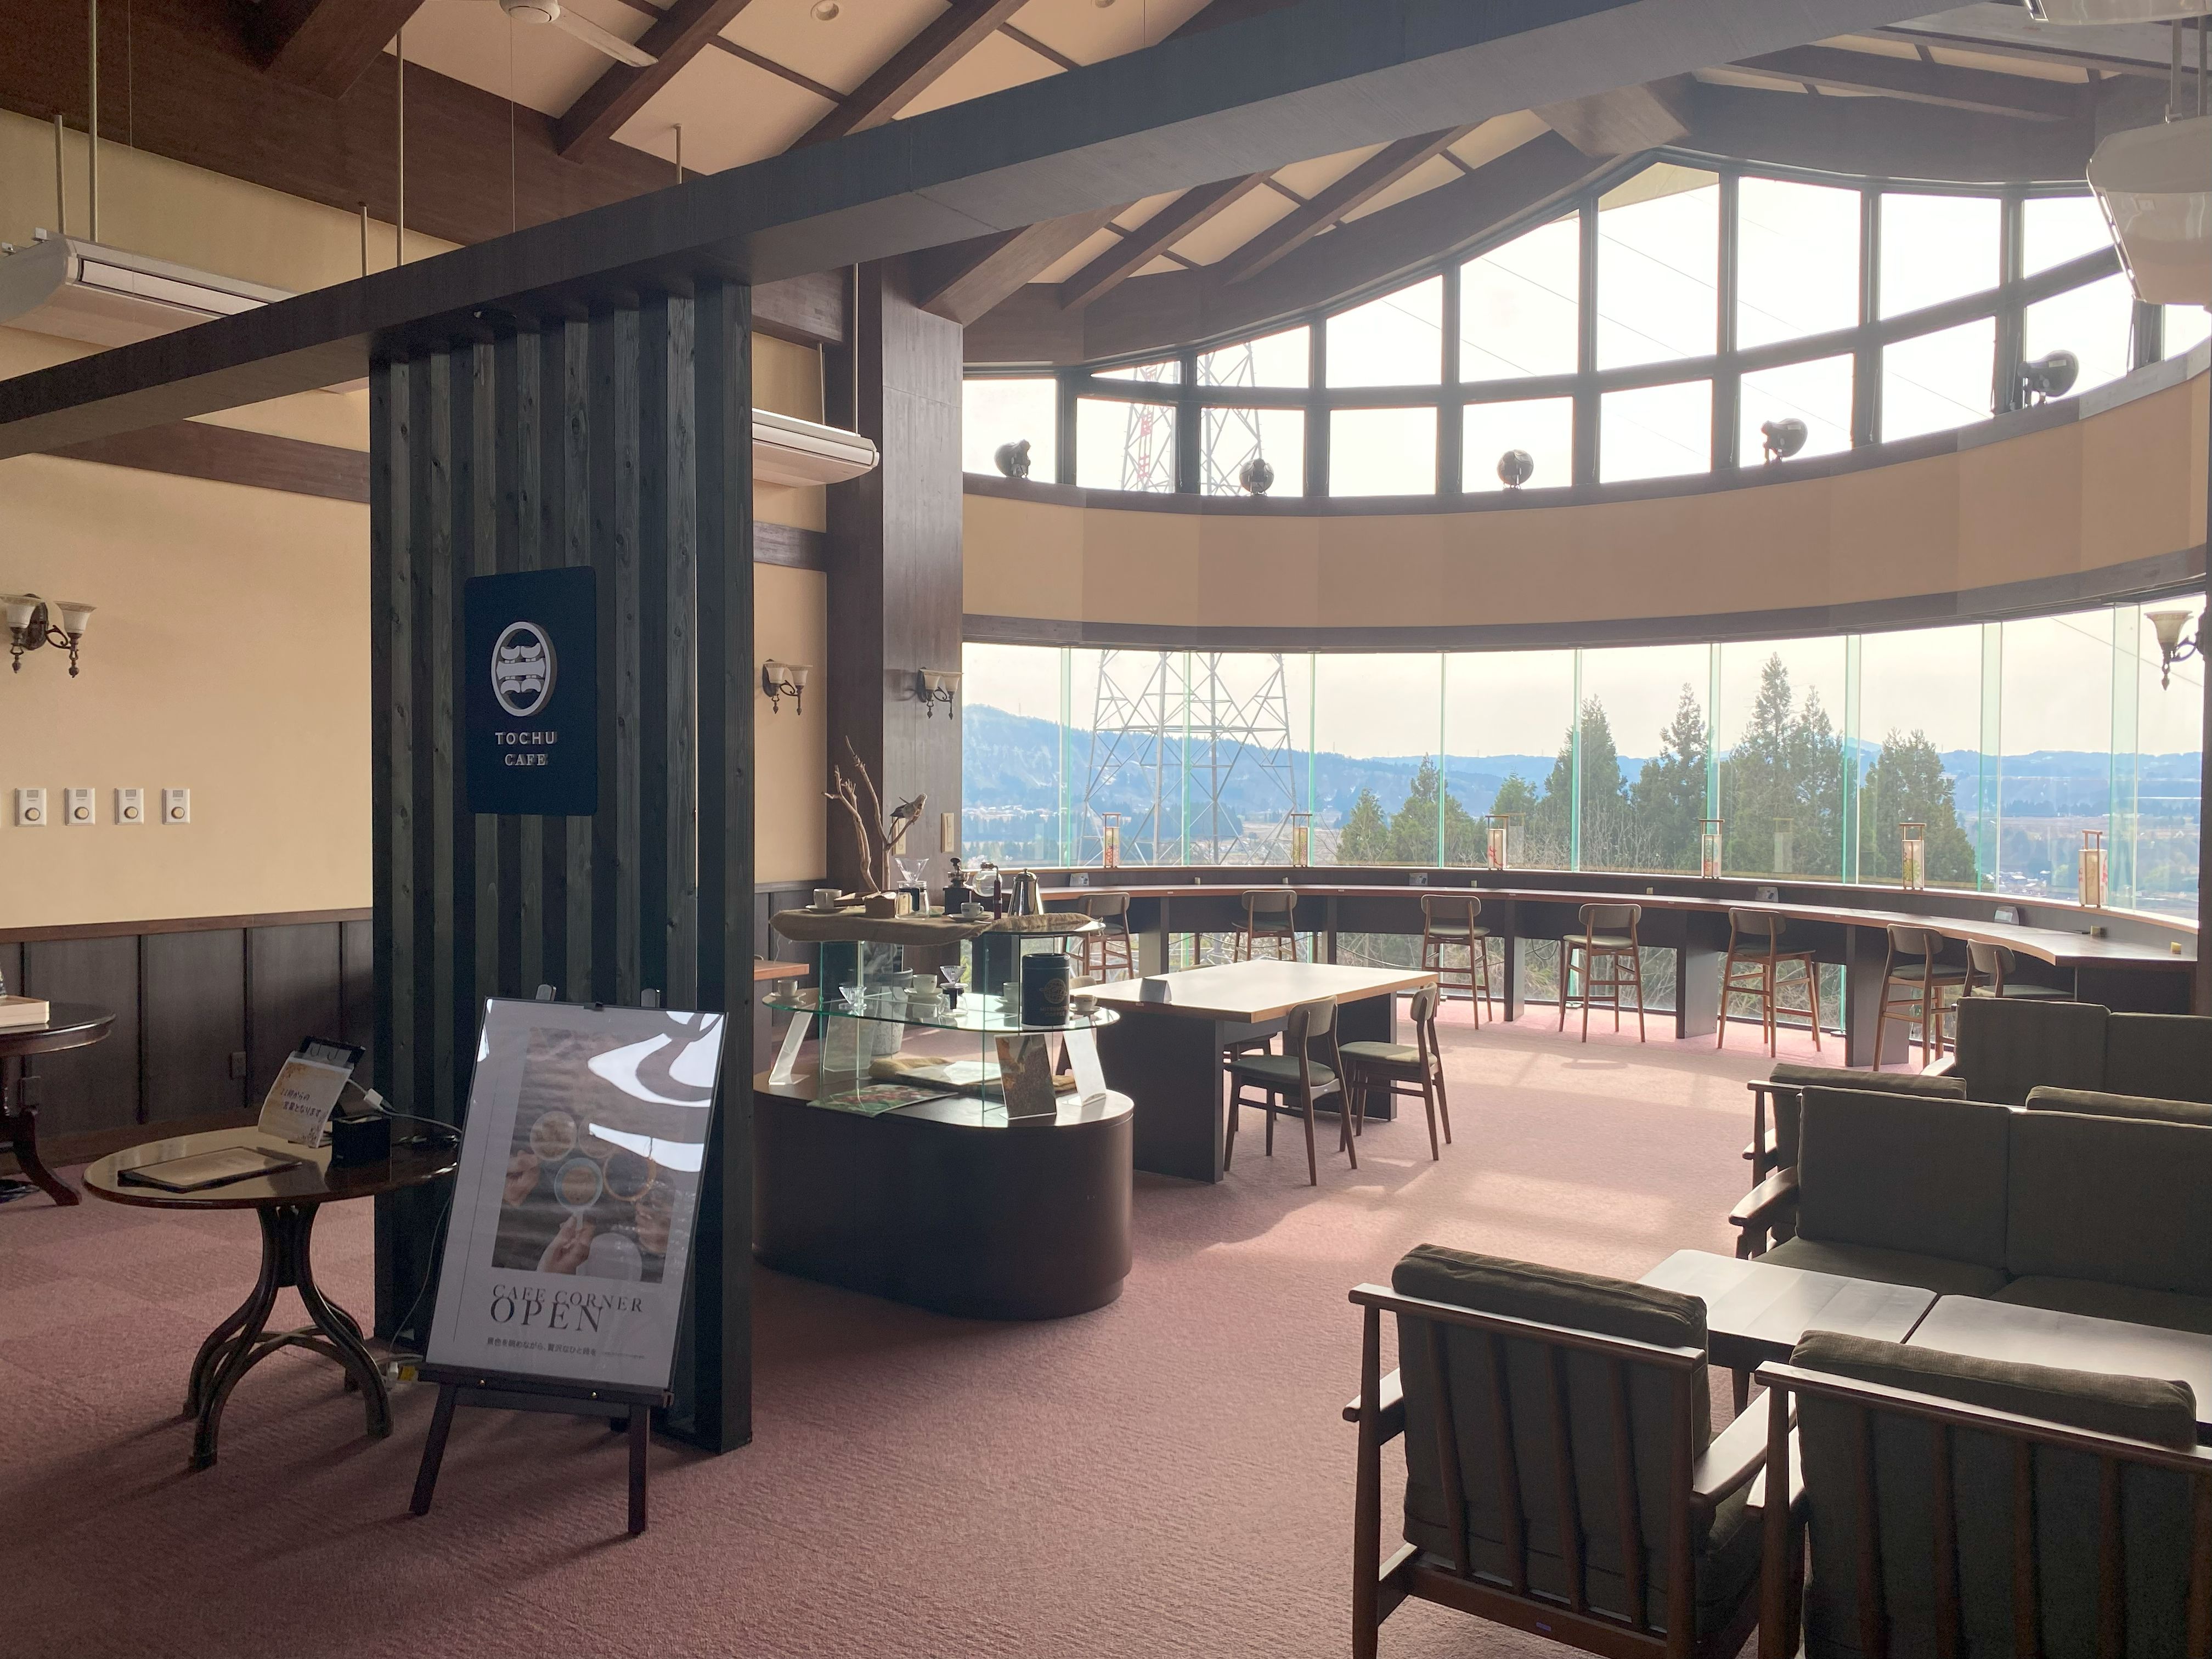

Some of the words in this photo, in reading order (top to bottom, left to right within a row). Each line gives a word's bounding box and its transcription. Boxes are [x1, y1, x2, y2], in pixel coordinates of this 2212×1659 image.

[495, 731, 556, 745] TOCHU
[505, 753, 547, 766] CAFE
[493, 1284, 547, 1303] CAFE
[555, 1290, 644, 1313] CORNER
[490, 1296, 603, 1333] OPEN
